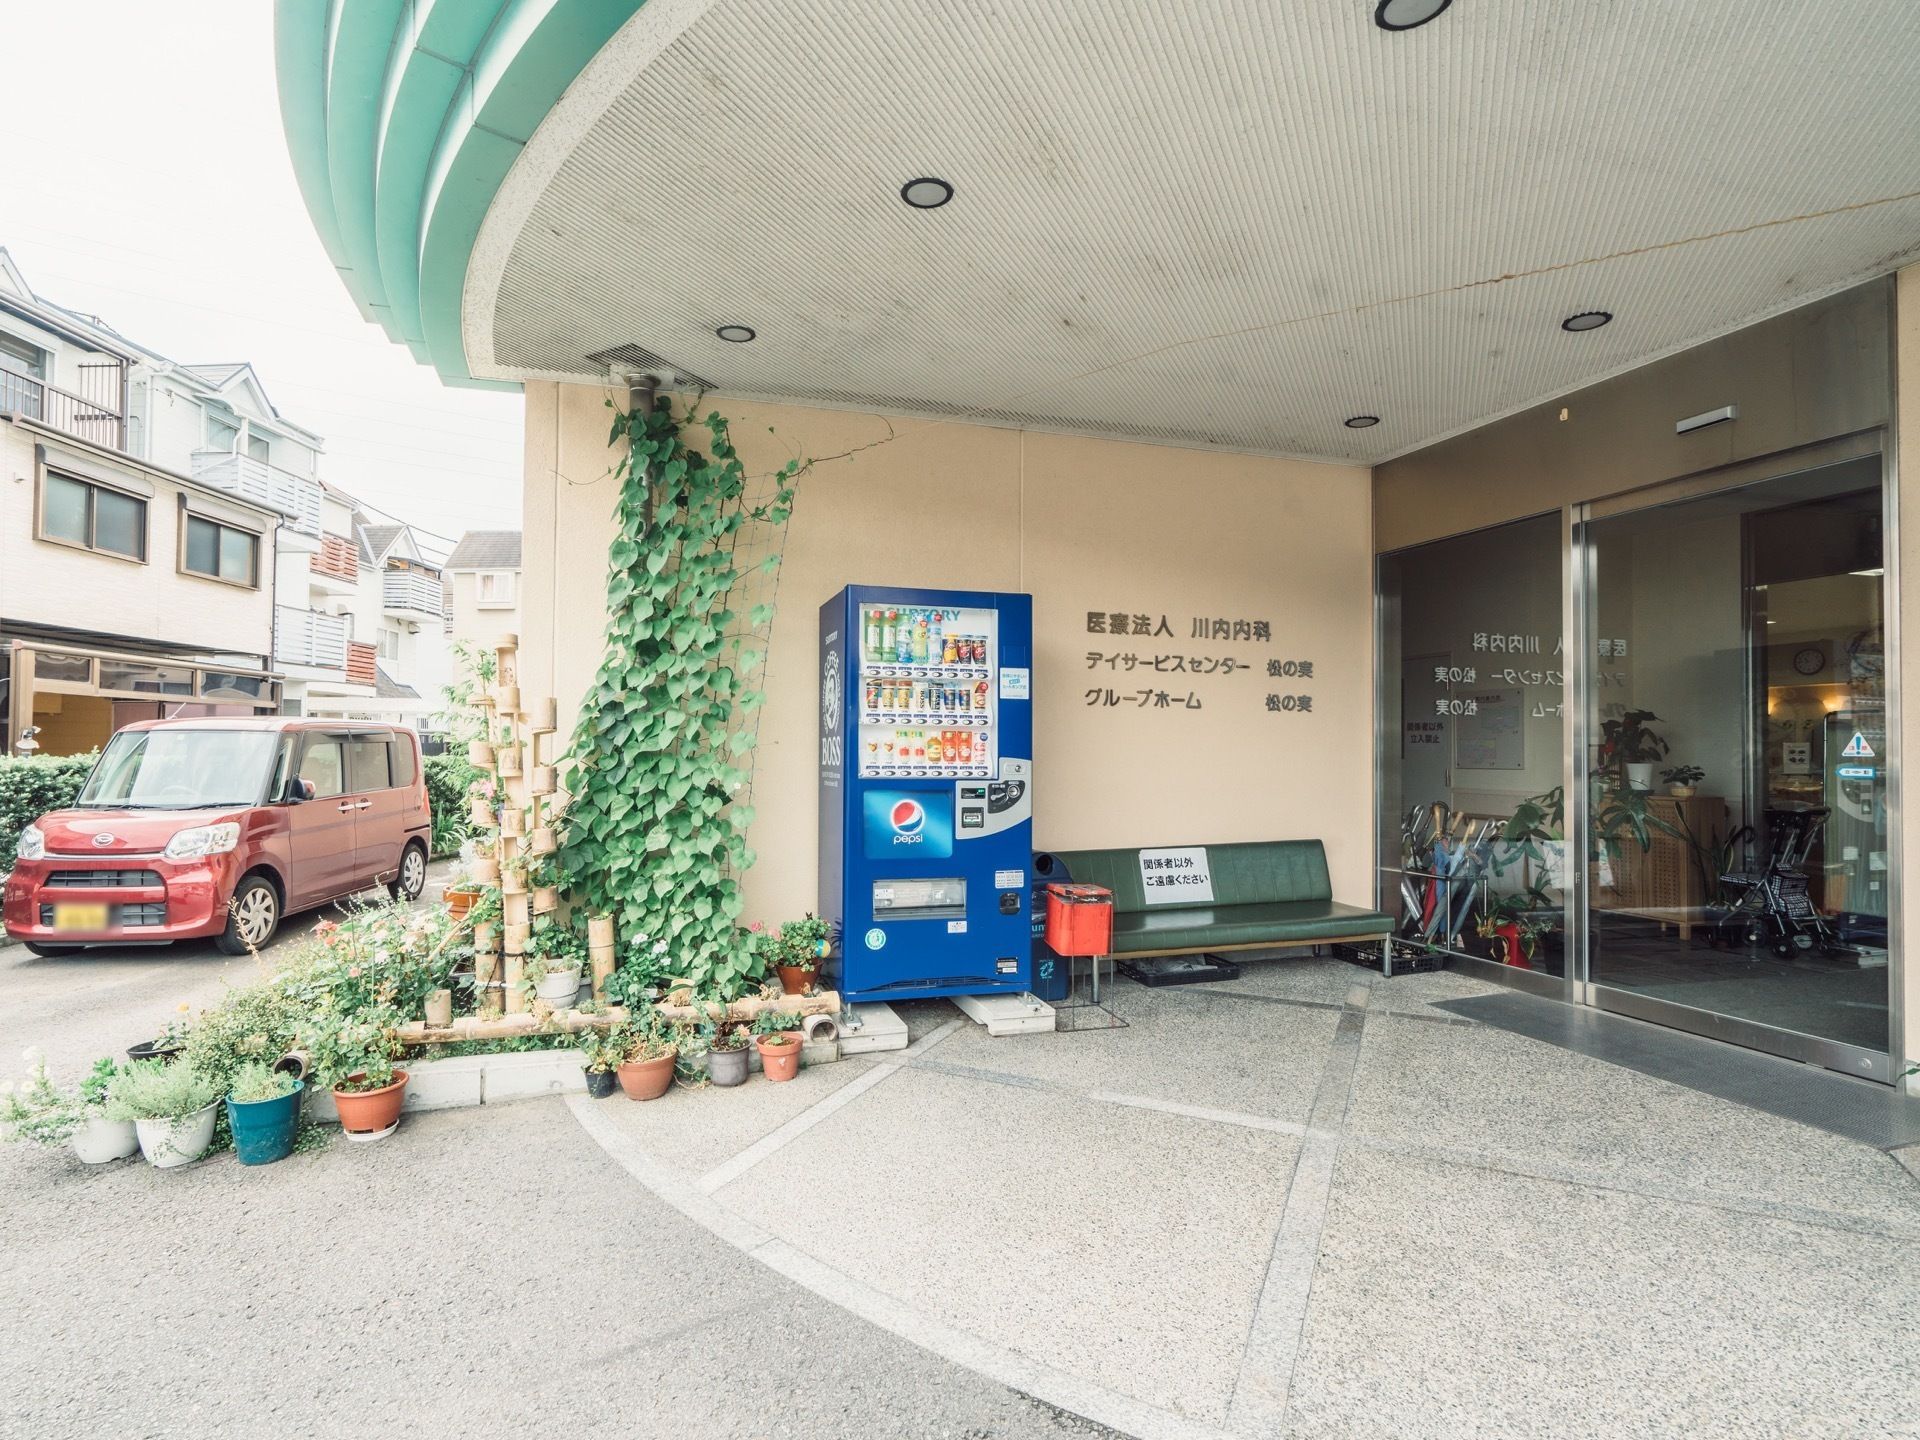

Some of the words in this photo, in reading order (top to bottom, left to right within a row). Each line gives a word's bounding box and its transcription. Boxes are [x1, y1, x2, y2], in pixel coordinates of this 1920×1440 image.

[1086, 611, 1174, 638] 医療法人
[1191, 617, 1271, 642] 川内内科
[1266, 659, 1313, 679] 松の実
[1084, 688, 1202, 709] グループホーム
[1265, 694, 1313, 713] 松の実
[822, 735, 841, 766] BOSS
[893, 834, 923, 845] pepsi
[1143, 857, 1194, 870] 関係者以外
[1146, 874, 1209, 887] ご遠慮ください
